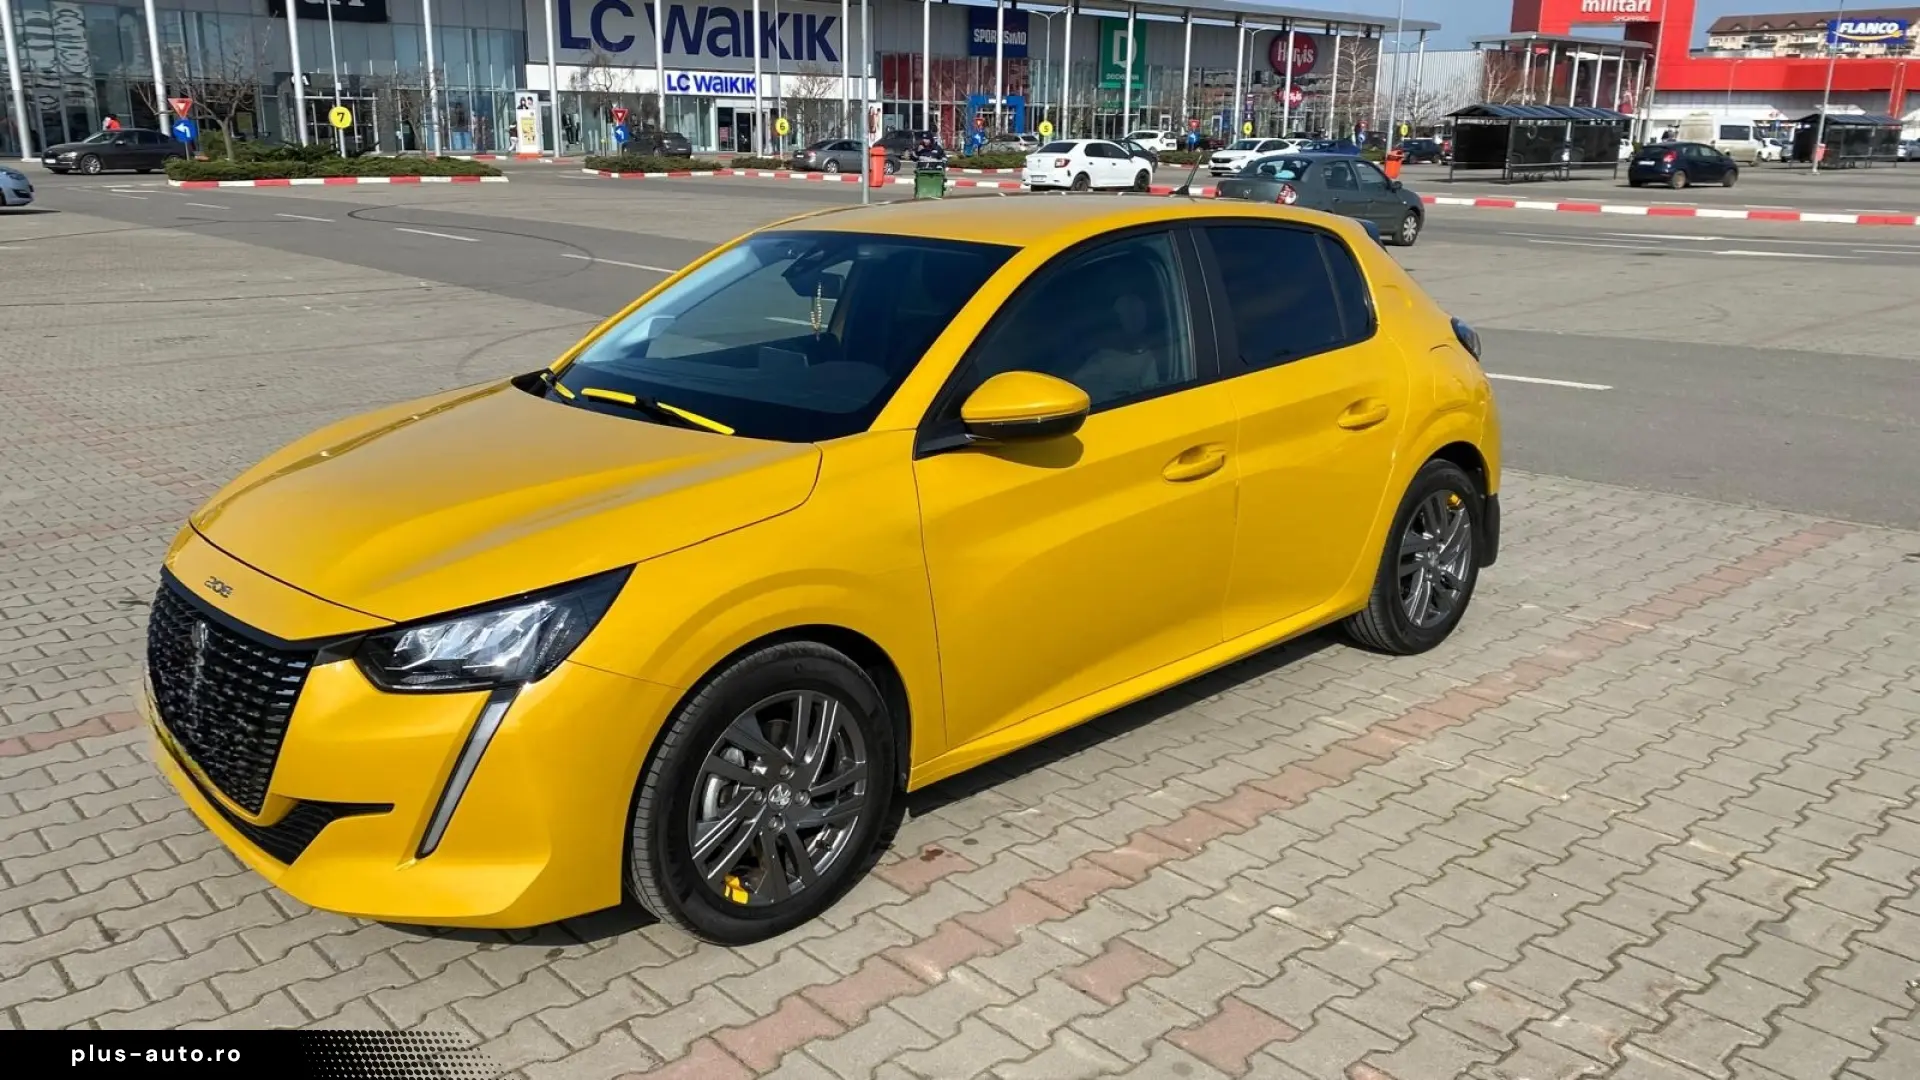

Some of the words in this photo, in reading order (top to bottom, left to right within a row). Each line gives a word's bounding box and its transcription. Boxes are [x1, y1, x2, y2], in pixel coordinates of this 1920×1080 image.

[558, 0, 635, 53] LC
[1840, 22, 1899, 34] FLANCO
[973, 29, 1027, 45] SPORSIMO
[1278, 41, 1314, 67] Hrvis
[666, 74, 691, 92] LC
[337, 112, 345, 123] 7
[779, 122, 786, 131] 6
[1043, 125, 1049, 133] 5
